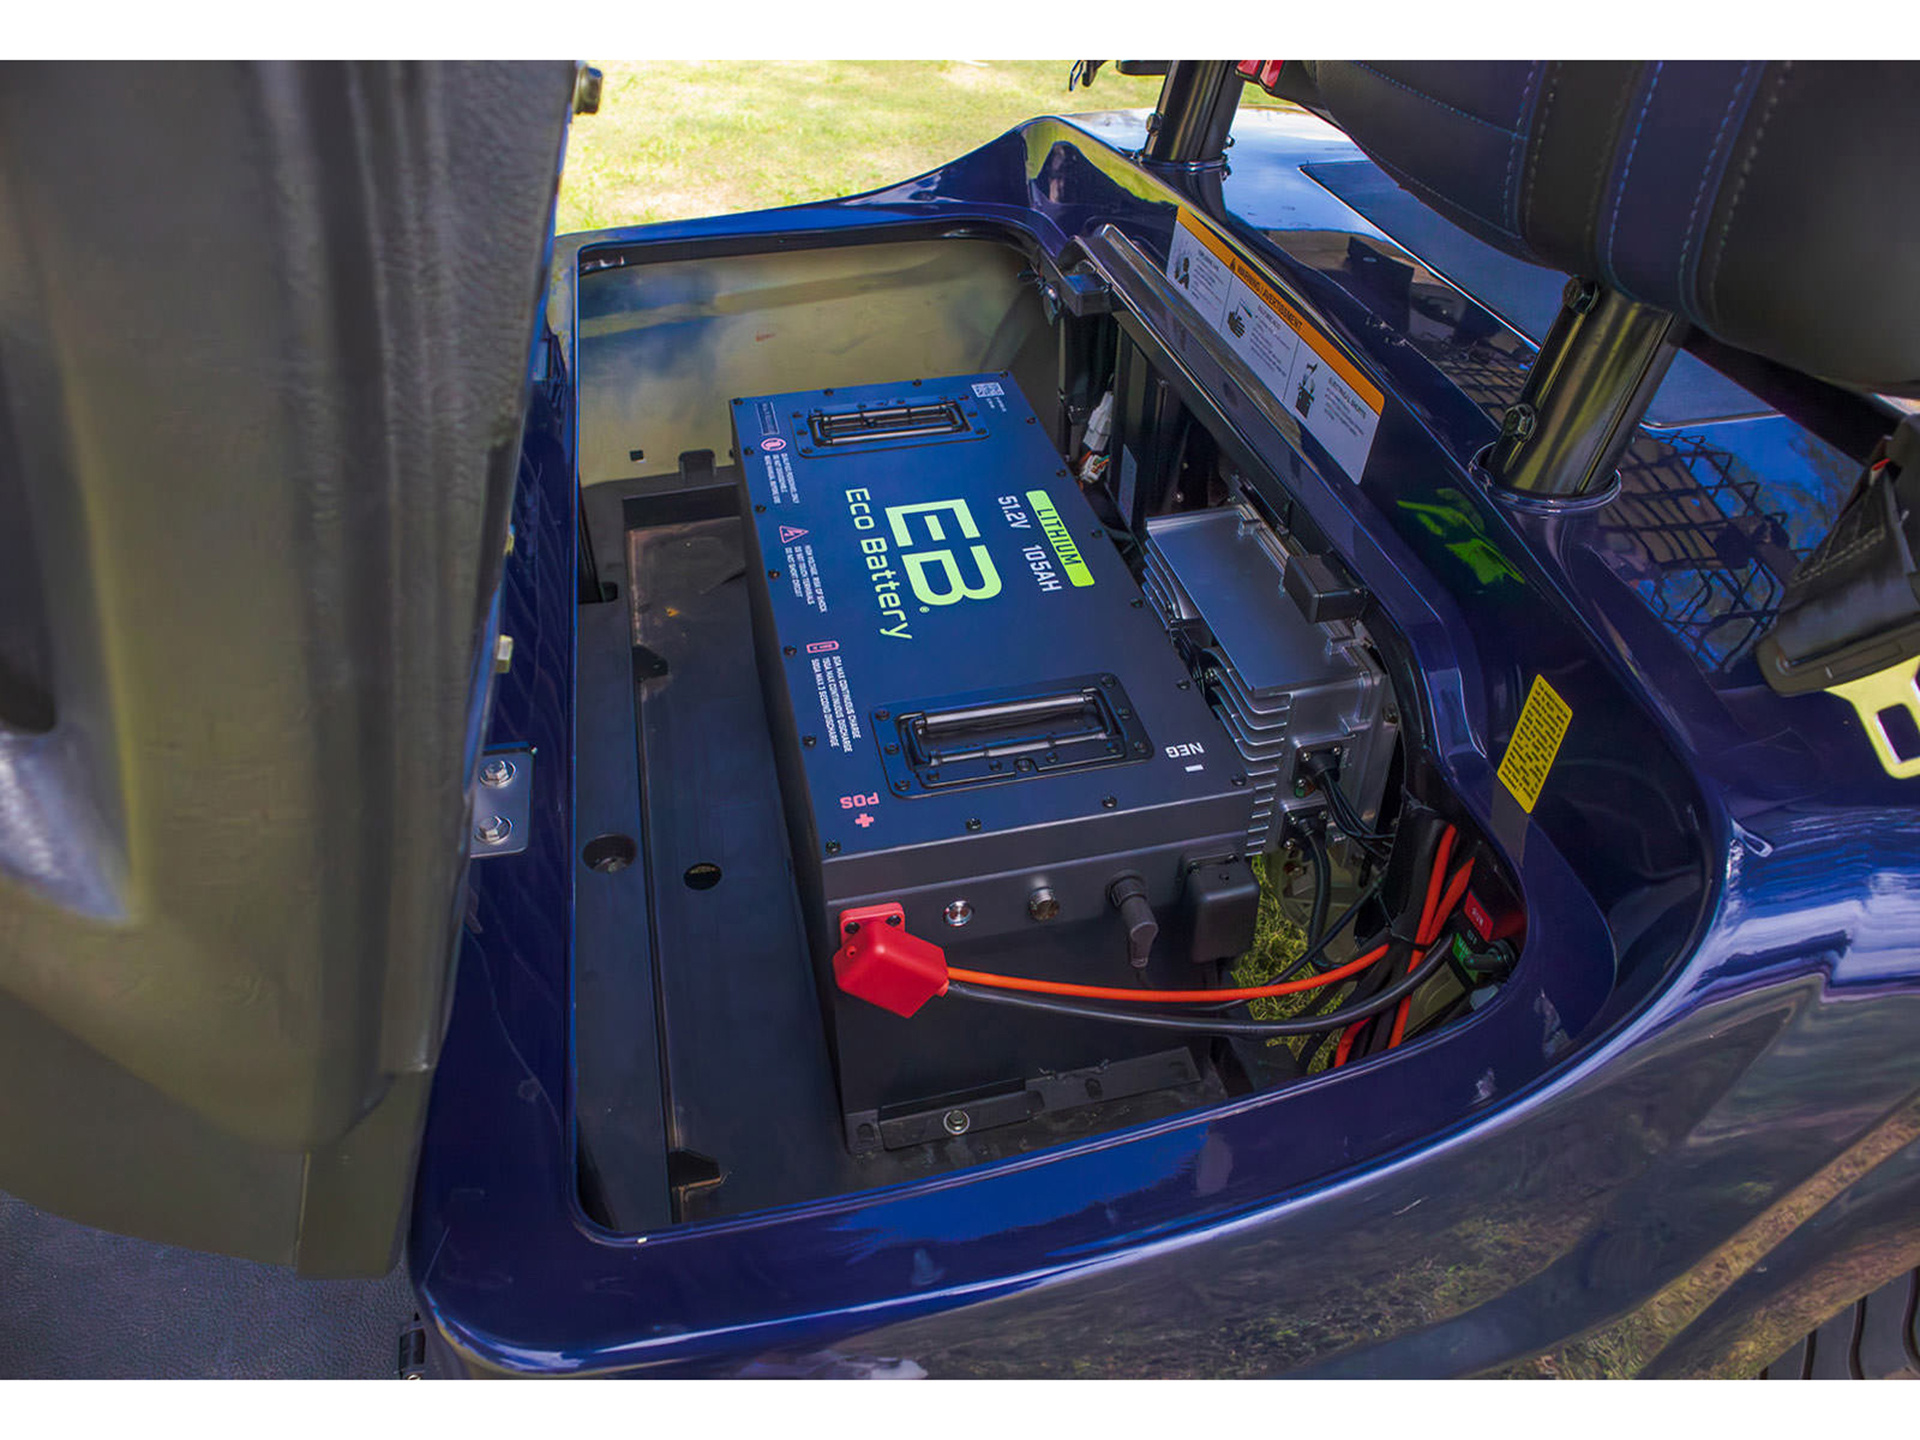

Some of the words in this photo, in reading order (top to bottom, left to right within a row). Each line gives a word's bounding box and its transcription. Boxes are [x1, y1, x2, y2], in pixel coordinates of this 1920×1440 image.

[845, 487, 875, 530] Eco
[860, 537, 913, 639] Battery
[885, 499, 1002, 606] EB
[998, 495, 1031, 529] 51.2V
[1022, 544, 1063, 592] 105AH
[1036, 508, 1082, 566] LITHIUM
[819, 691, 831, 714] SECOND
[824, 713, 839, 747] DISCHARGE
[829, 683, 844, 719] CONTINUOUS
[837, 719, 853, 753] DISCHARGE
[839, 679, 855, 714] CONTINUOUS
[848, 714, 861, 739] CHARGE
[1166, 742, 1204, 759] NEG
[840, 792, 880, 809] POS
